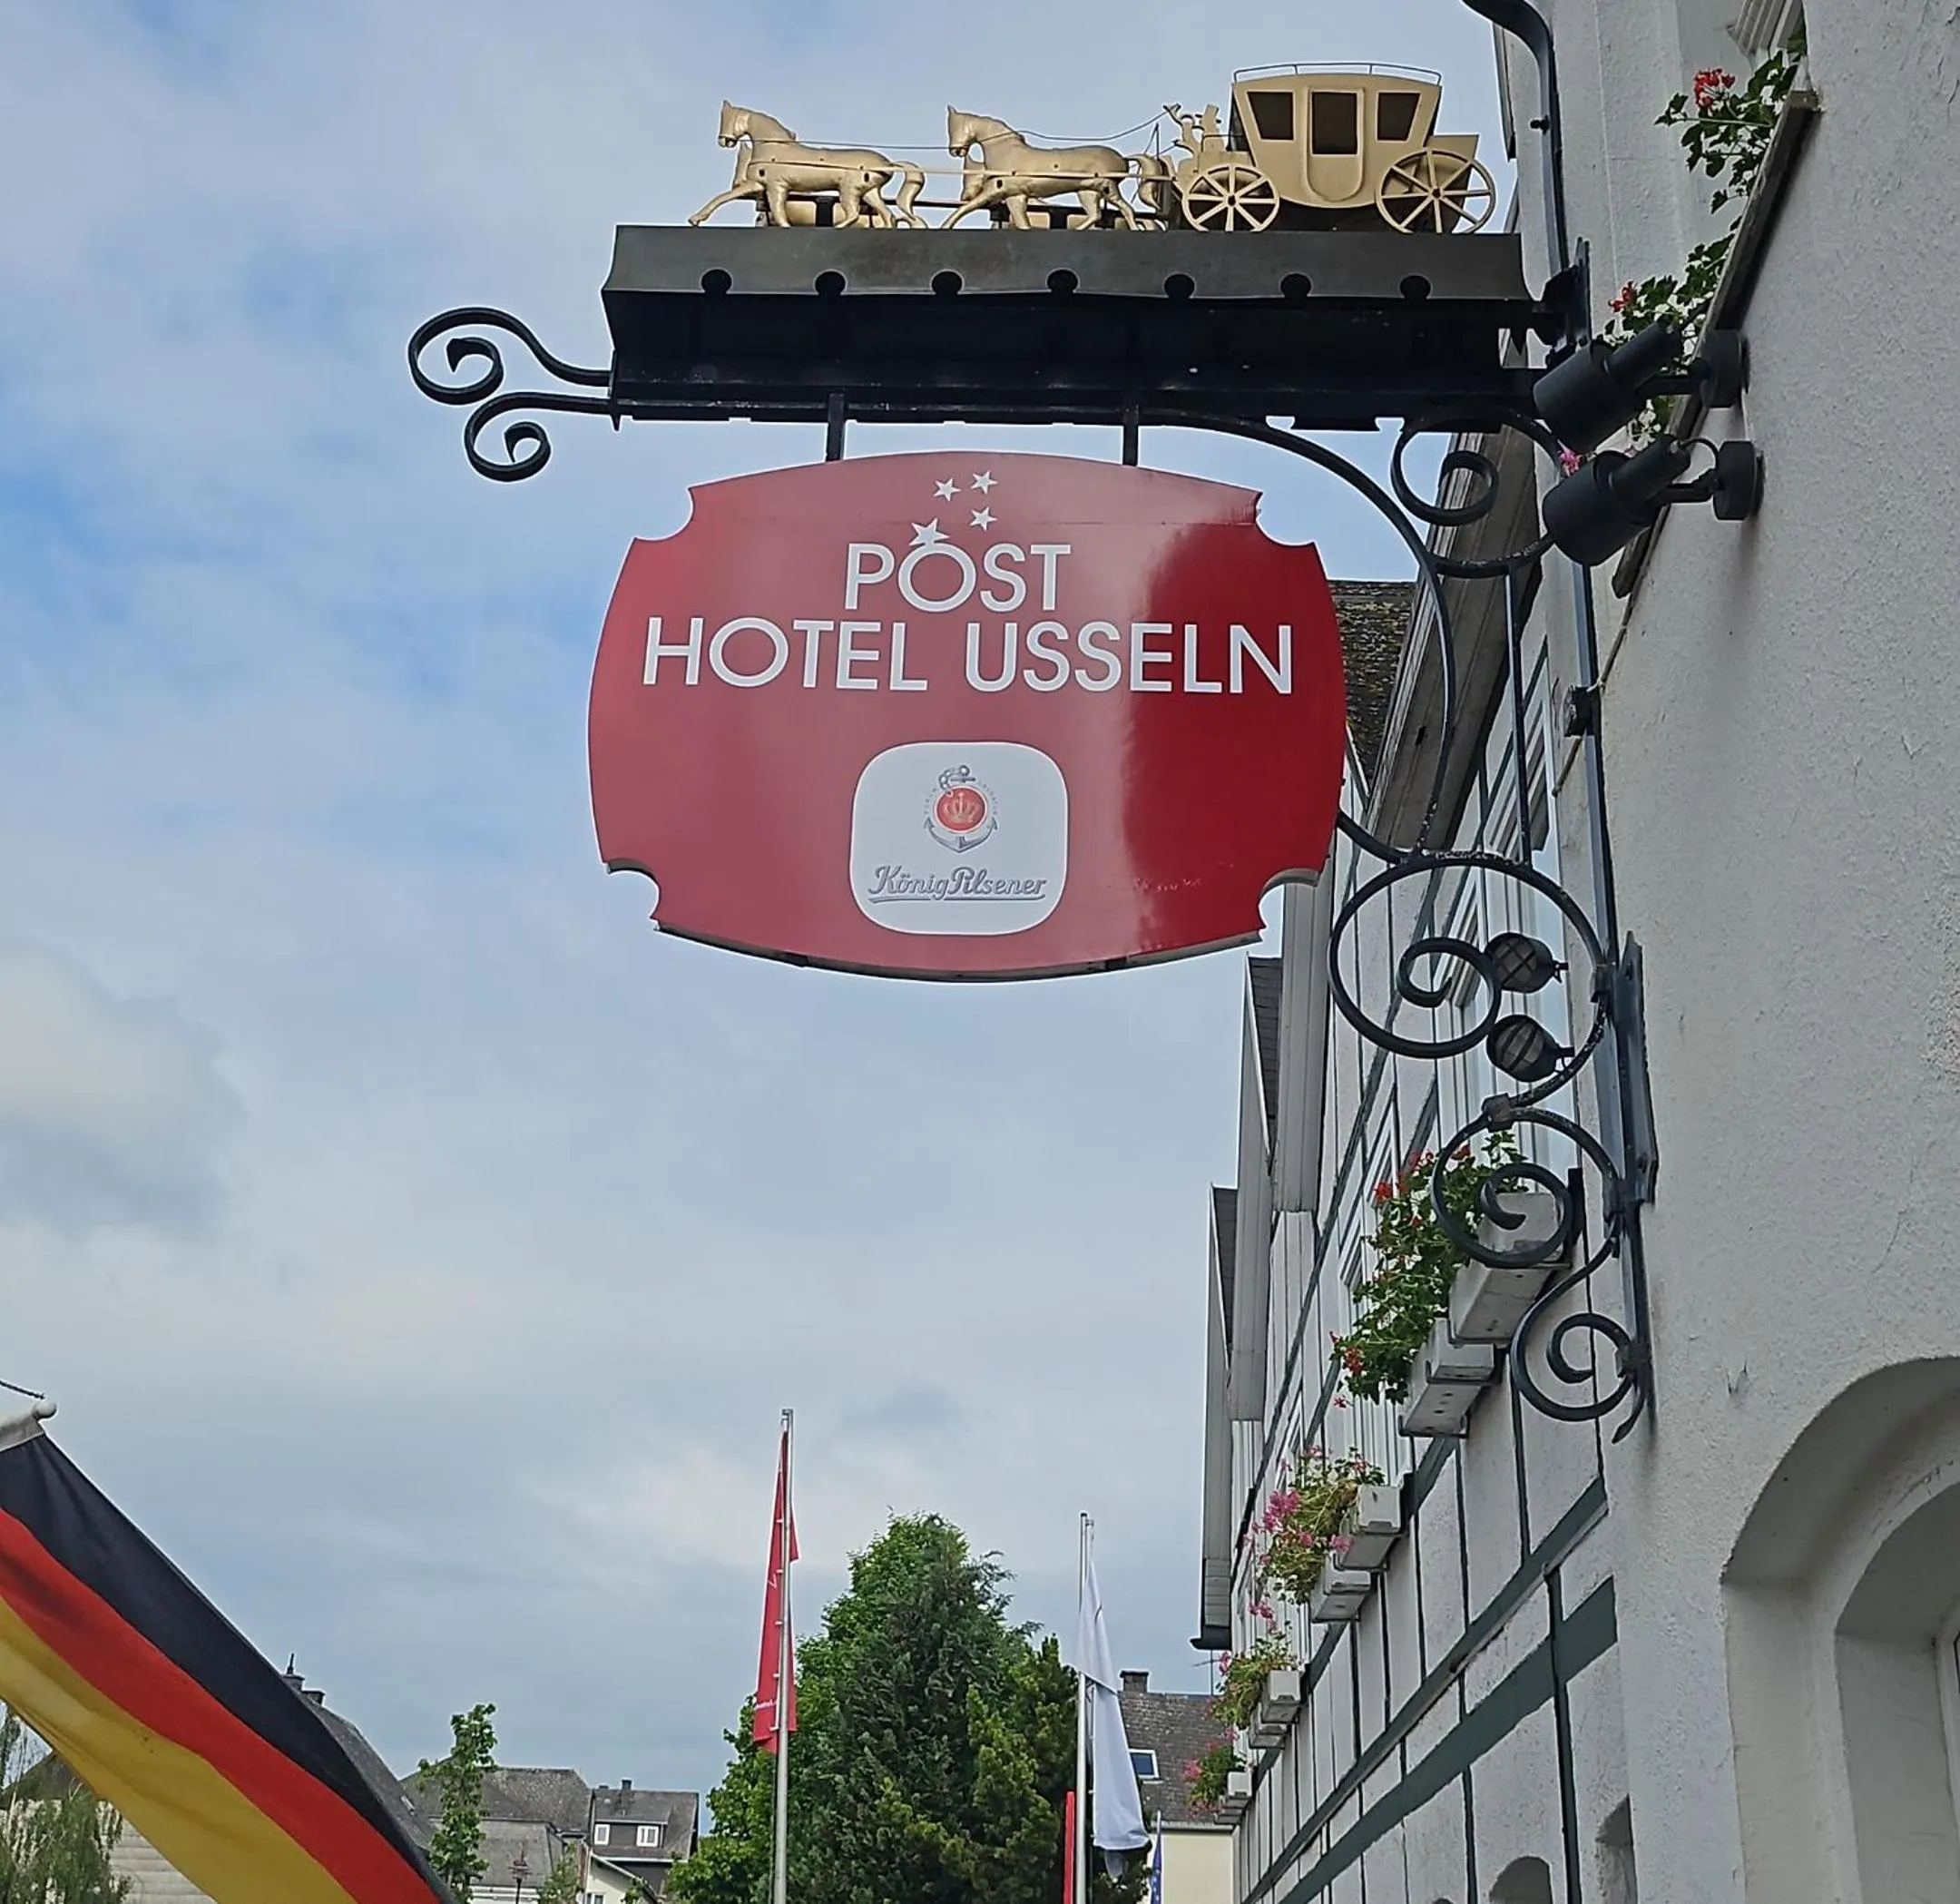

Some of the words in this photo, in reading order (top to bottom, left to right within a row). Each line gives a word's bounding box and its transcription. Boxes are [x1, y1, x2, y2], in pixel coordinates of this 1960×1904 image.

[845, 542, 1072, 613] POST
[642, 616, 929, 691] HOTEL
[965, 621, 1293, 694] USSELN
[867, 865, 949, 901] König
[947, 867, 1047, 896] Pilsener
